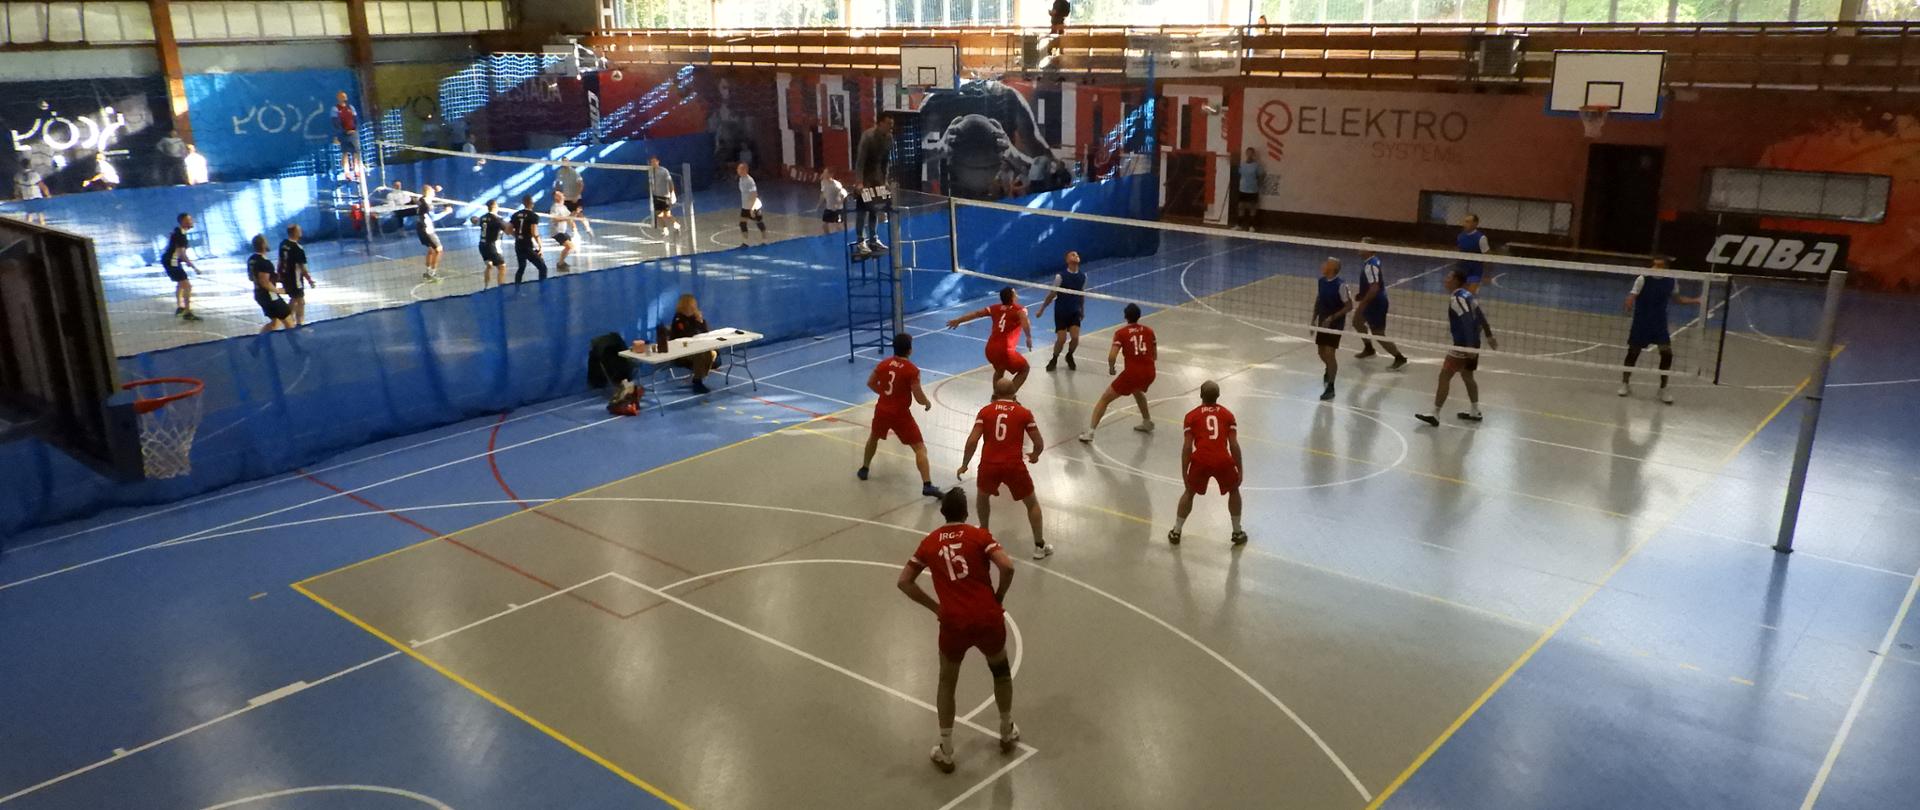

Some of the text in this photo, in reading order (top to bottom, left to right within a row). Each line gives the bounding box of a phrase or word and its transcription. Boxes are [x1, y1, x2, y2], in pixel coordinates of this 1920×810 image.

[1298, 105, 1468, 142] ELEKTRO
[1705, 234, 1839, 274] CNBA
[998, 312, 1006, 333] 4
[1129, 334, 1147, 356] 14
[884, 370, 896, 396] 3
[995, 413, 1008, 442] 6
[1206, 415, 1219, 440] 9
[938, 543, 969, 581] 15
